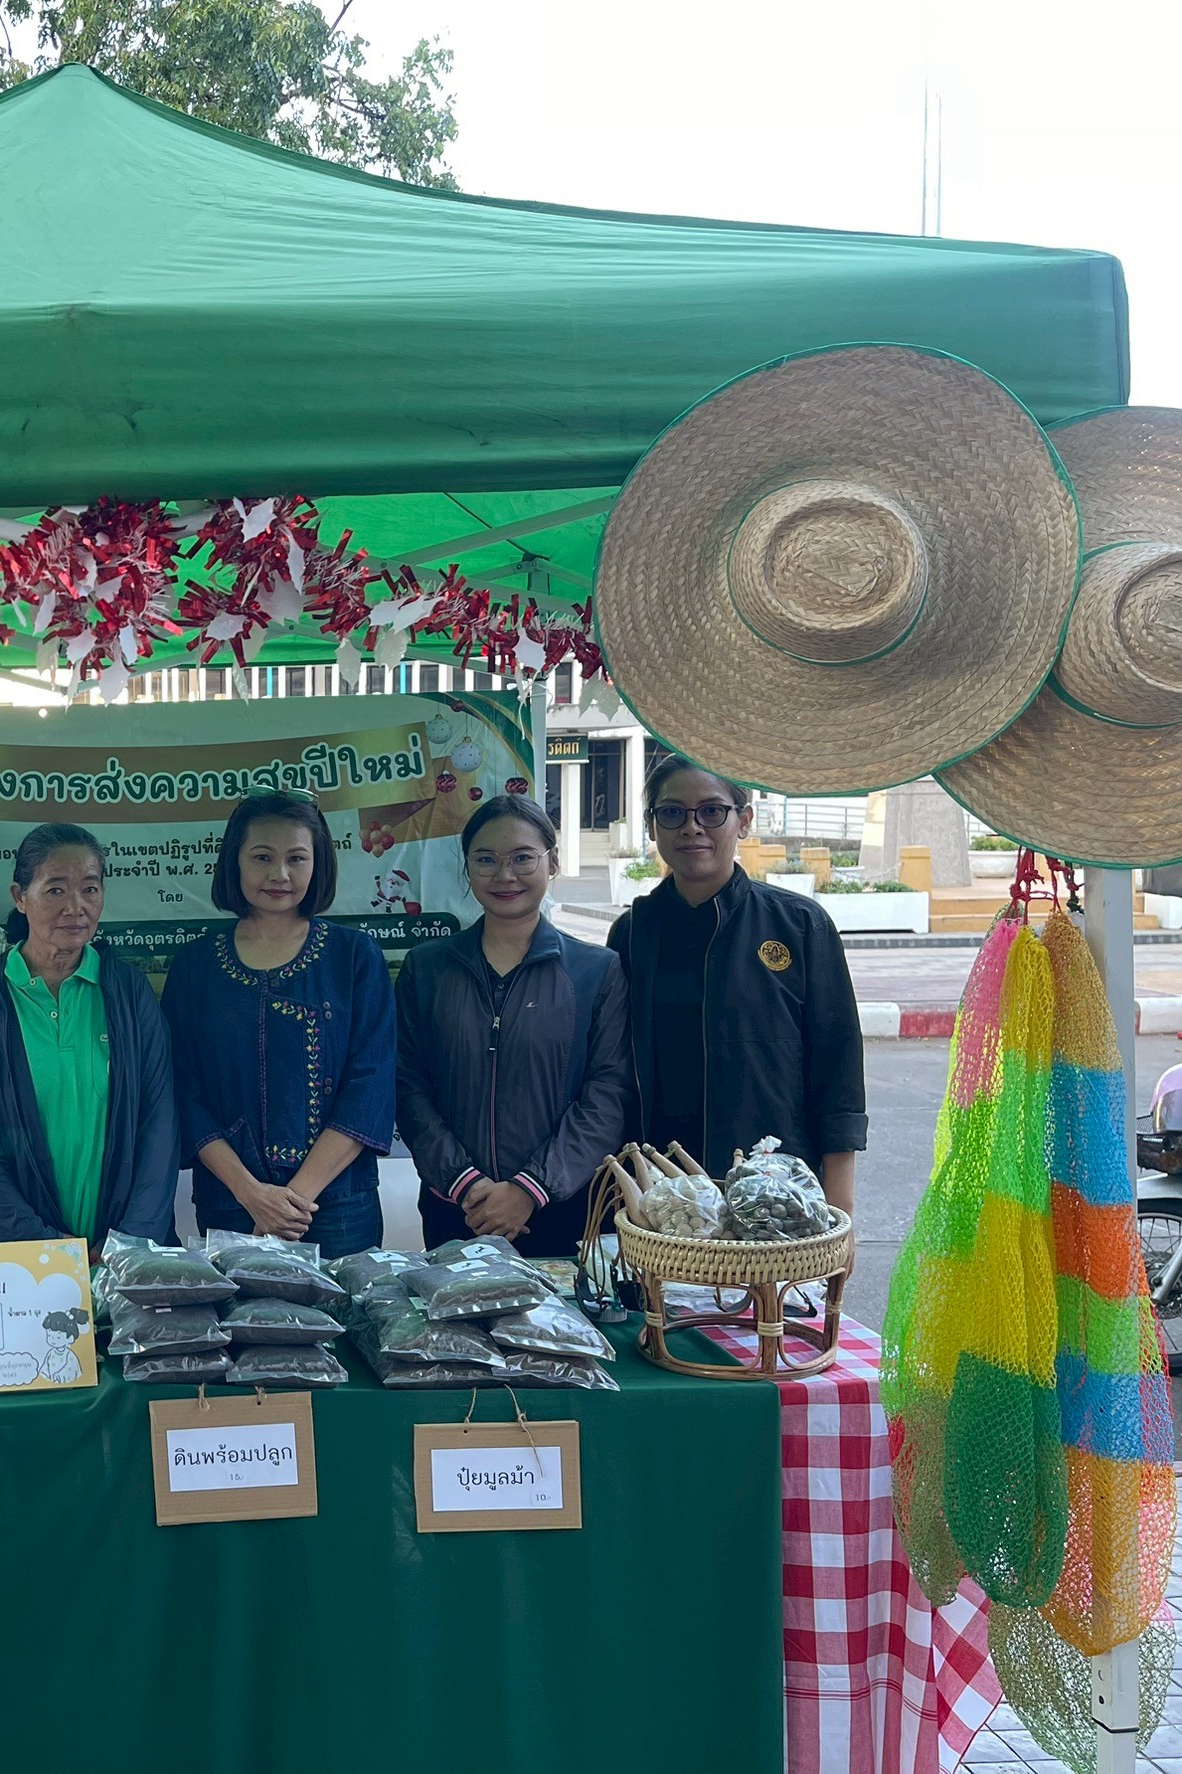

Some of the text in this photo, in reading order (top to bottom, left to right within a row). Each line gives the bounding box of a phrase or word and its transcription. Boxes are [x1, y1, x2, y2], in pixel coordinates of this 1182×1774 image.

[157, 889, 184, 902] โดย
[411, 920, 451, 937] จำกัด
[174, 1443, 293, 1467] ดินพร้อมปลูก
[456, 1464, 535, 1492] ปุ๋ยมูลม้า
